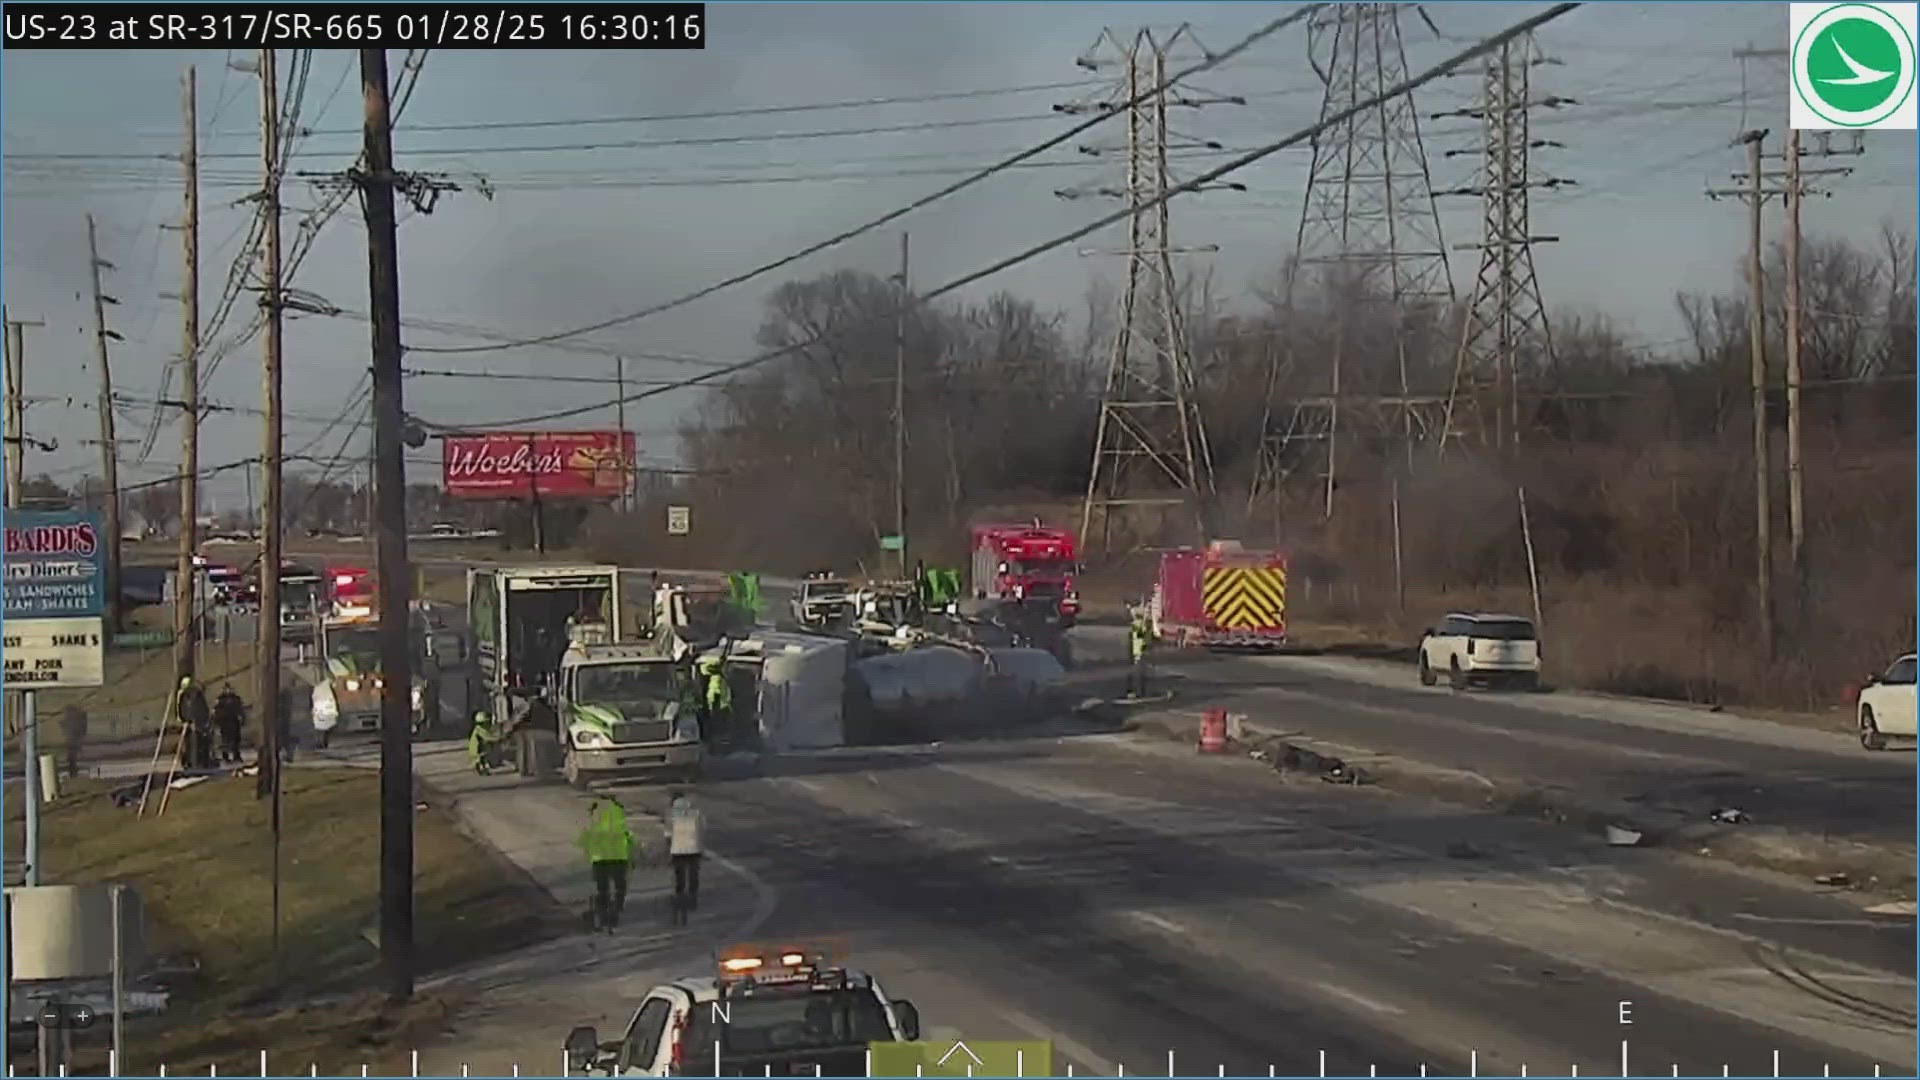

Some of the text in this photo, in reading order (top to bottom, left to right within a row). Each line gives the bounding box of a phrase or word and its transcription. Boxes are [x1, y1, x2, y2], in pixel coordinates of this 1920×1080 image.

[30, 561, 76, 577] Diner
[20, 583, 95, 598] SANDWICHES
[41, 597, 88, 610] SHAKES
[35, 659, 63, 670] PORK
